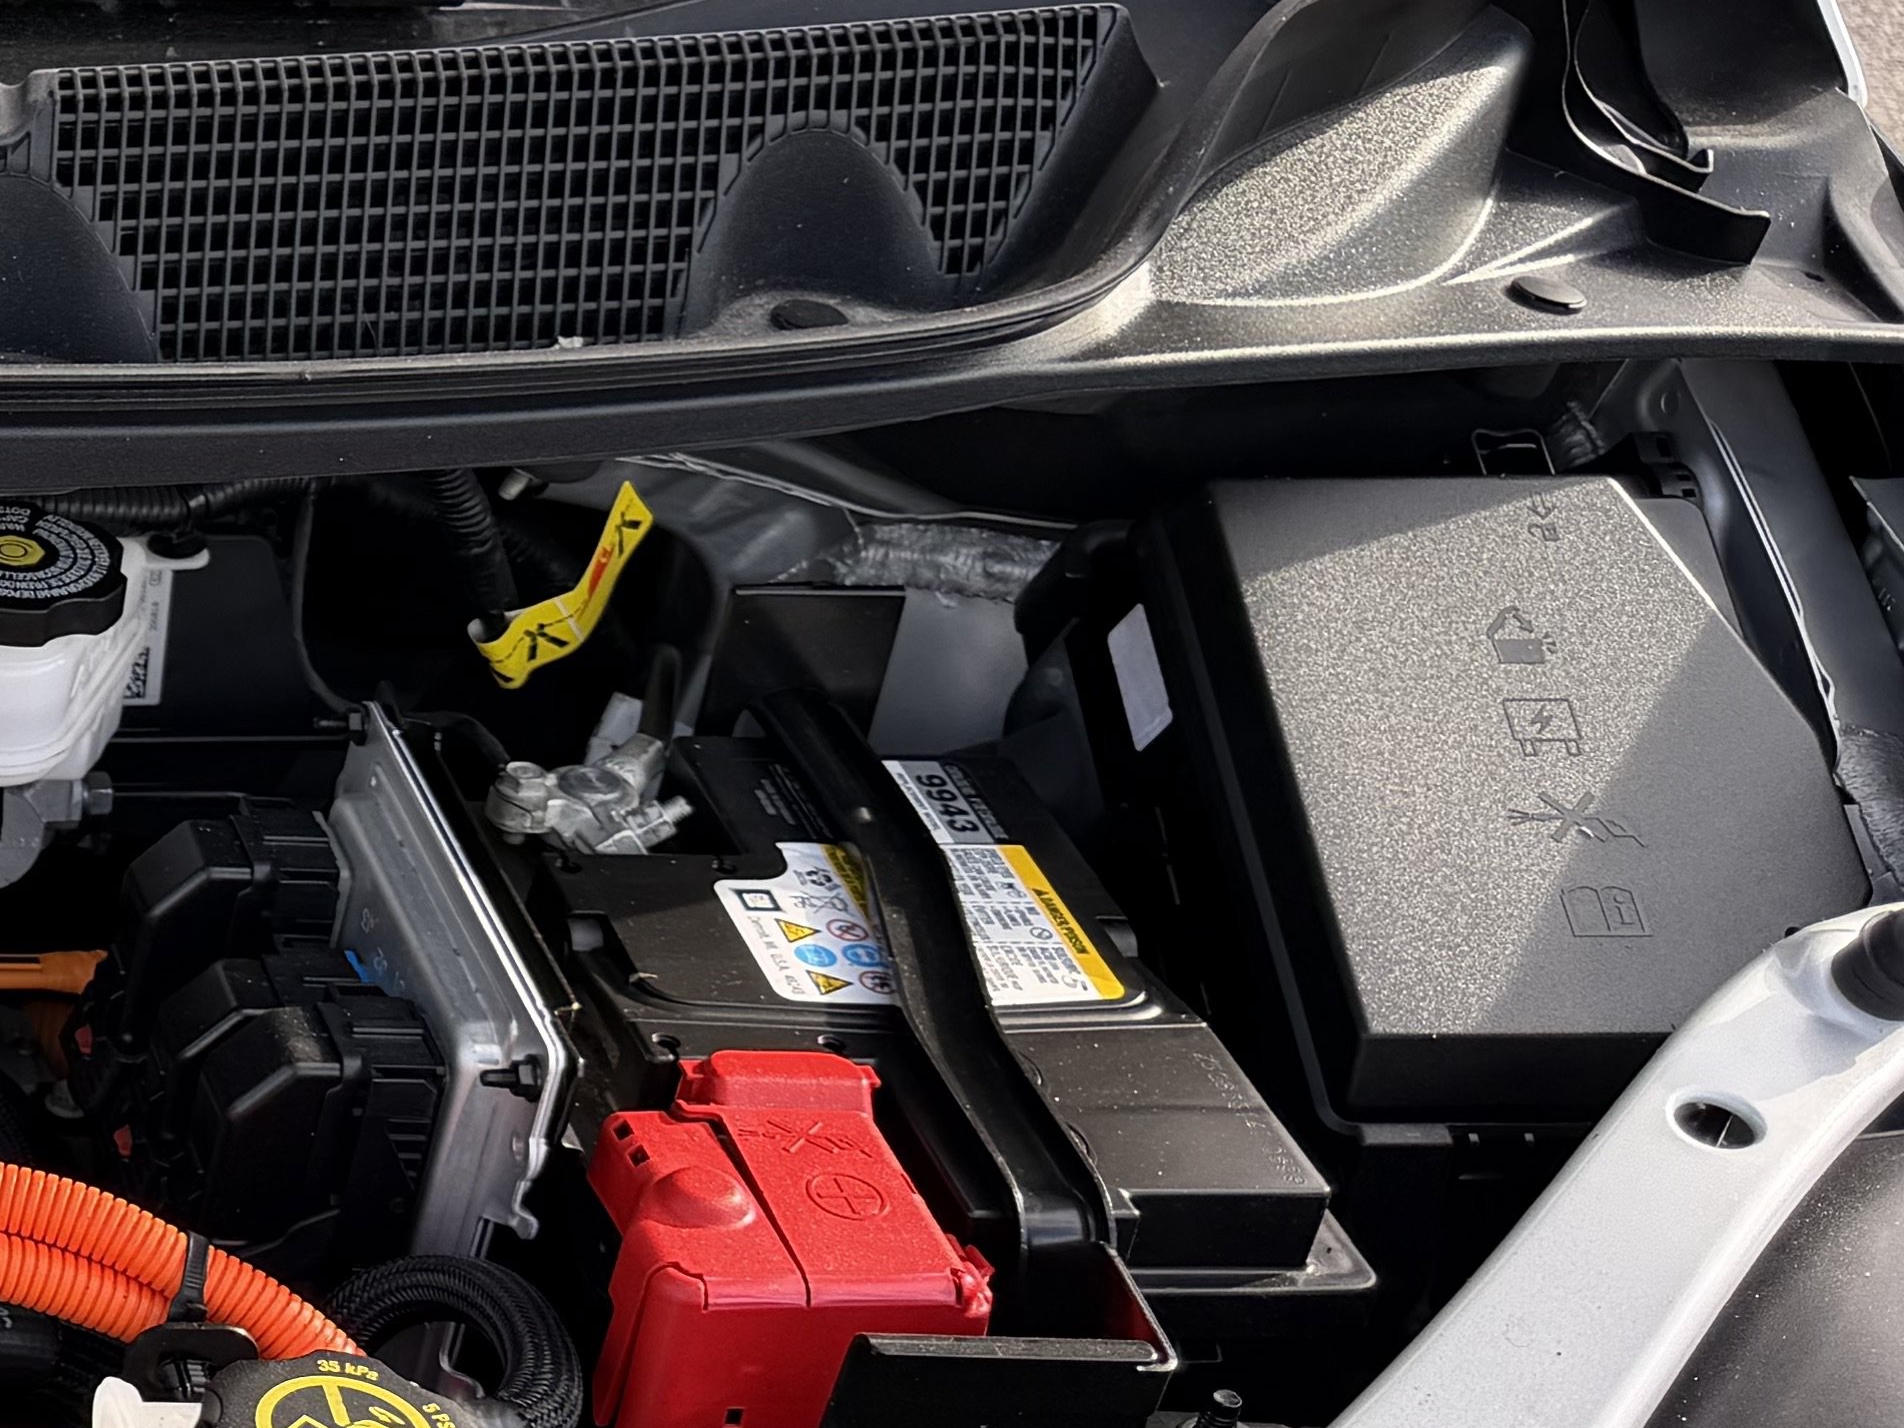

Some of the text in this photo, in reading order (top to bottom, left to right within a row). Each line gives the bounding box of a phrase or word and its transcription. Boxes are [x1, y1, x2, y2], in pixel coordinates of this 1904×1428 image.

[915, 773, 980, 834] 9943
[316, 1359, 379, 1382] 35 kPa
[421, 1402, 435, 1414] 5
